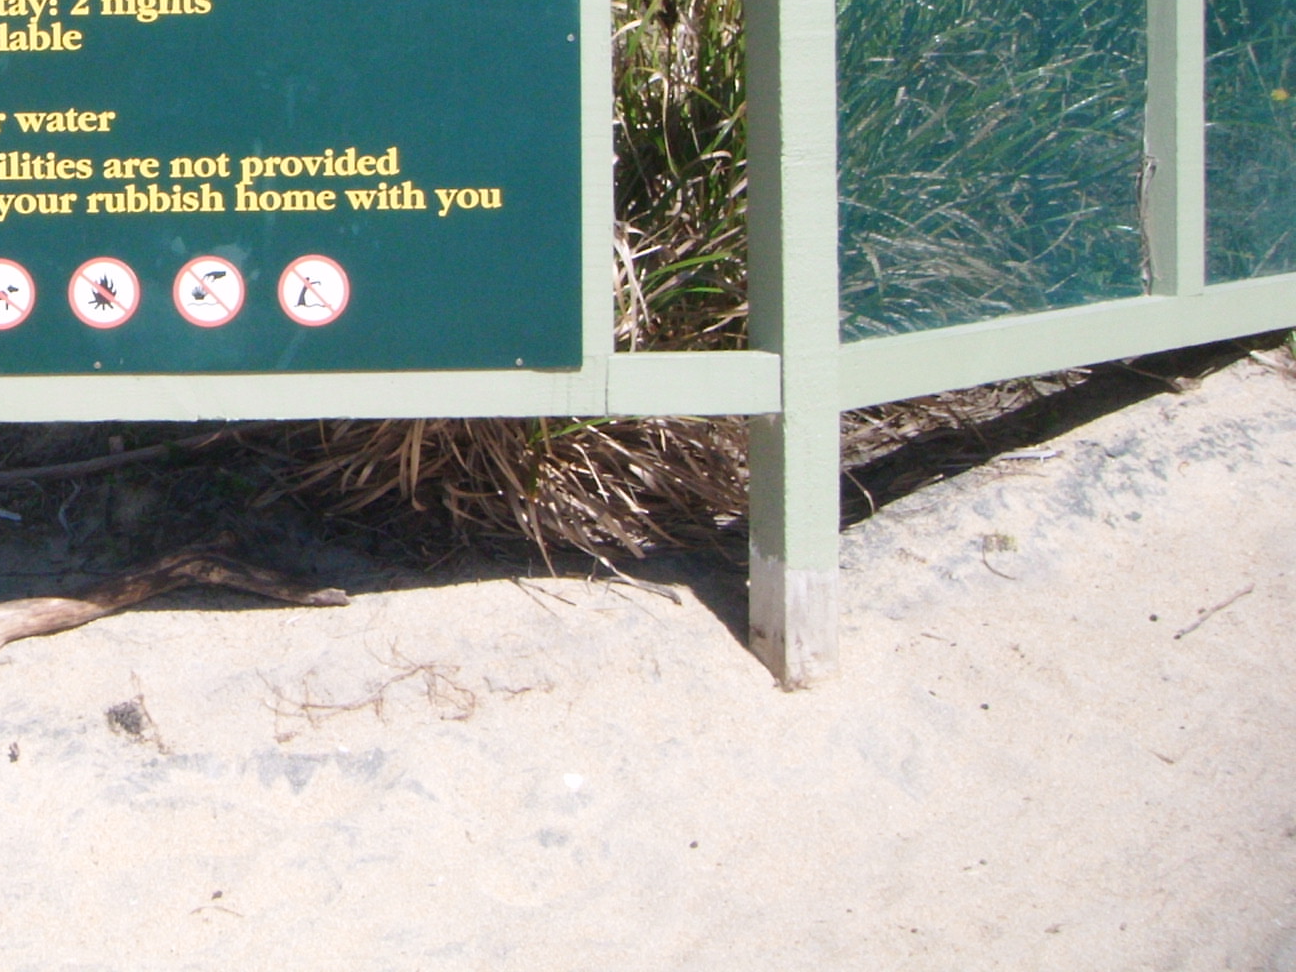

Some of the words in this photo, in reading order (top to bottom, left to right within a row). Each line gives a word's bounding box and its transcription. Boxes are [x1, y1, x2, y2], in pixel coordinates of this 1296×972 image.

[14, 108, 116, 132] water
[103, 158, 160, 179] are
[170, 153, 230, 178] not
[240, 147, 399, 185] provided
[86, 183, 226, 213] rubbish
[234, 182, 336, 211] home
[346, 181, 427, 210] with
[434, 188, 502, 217] you
